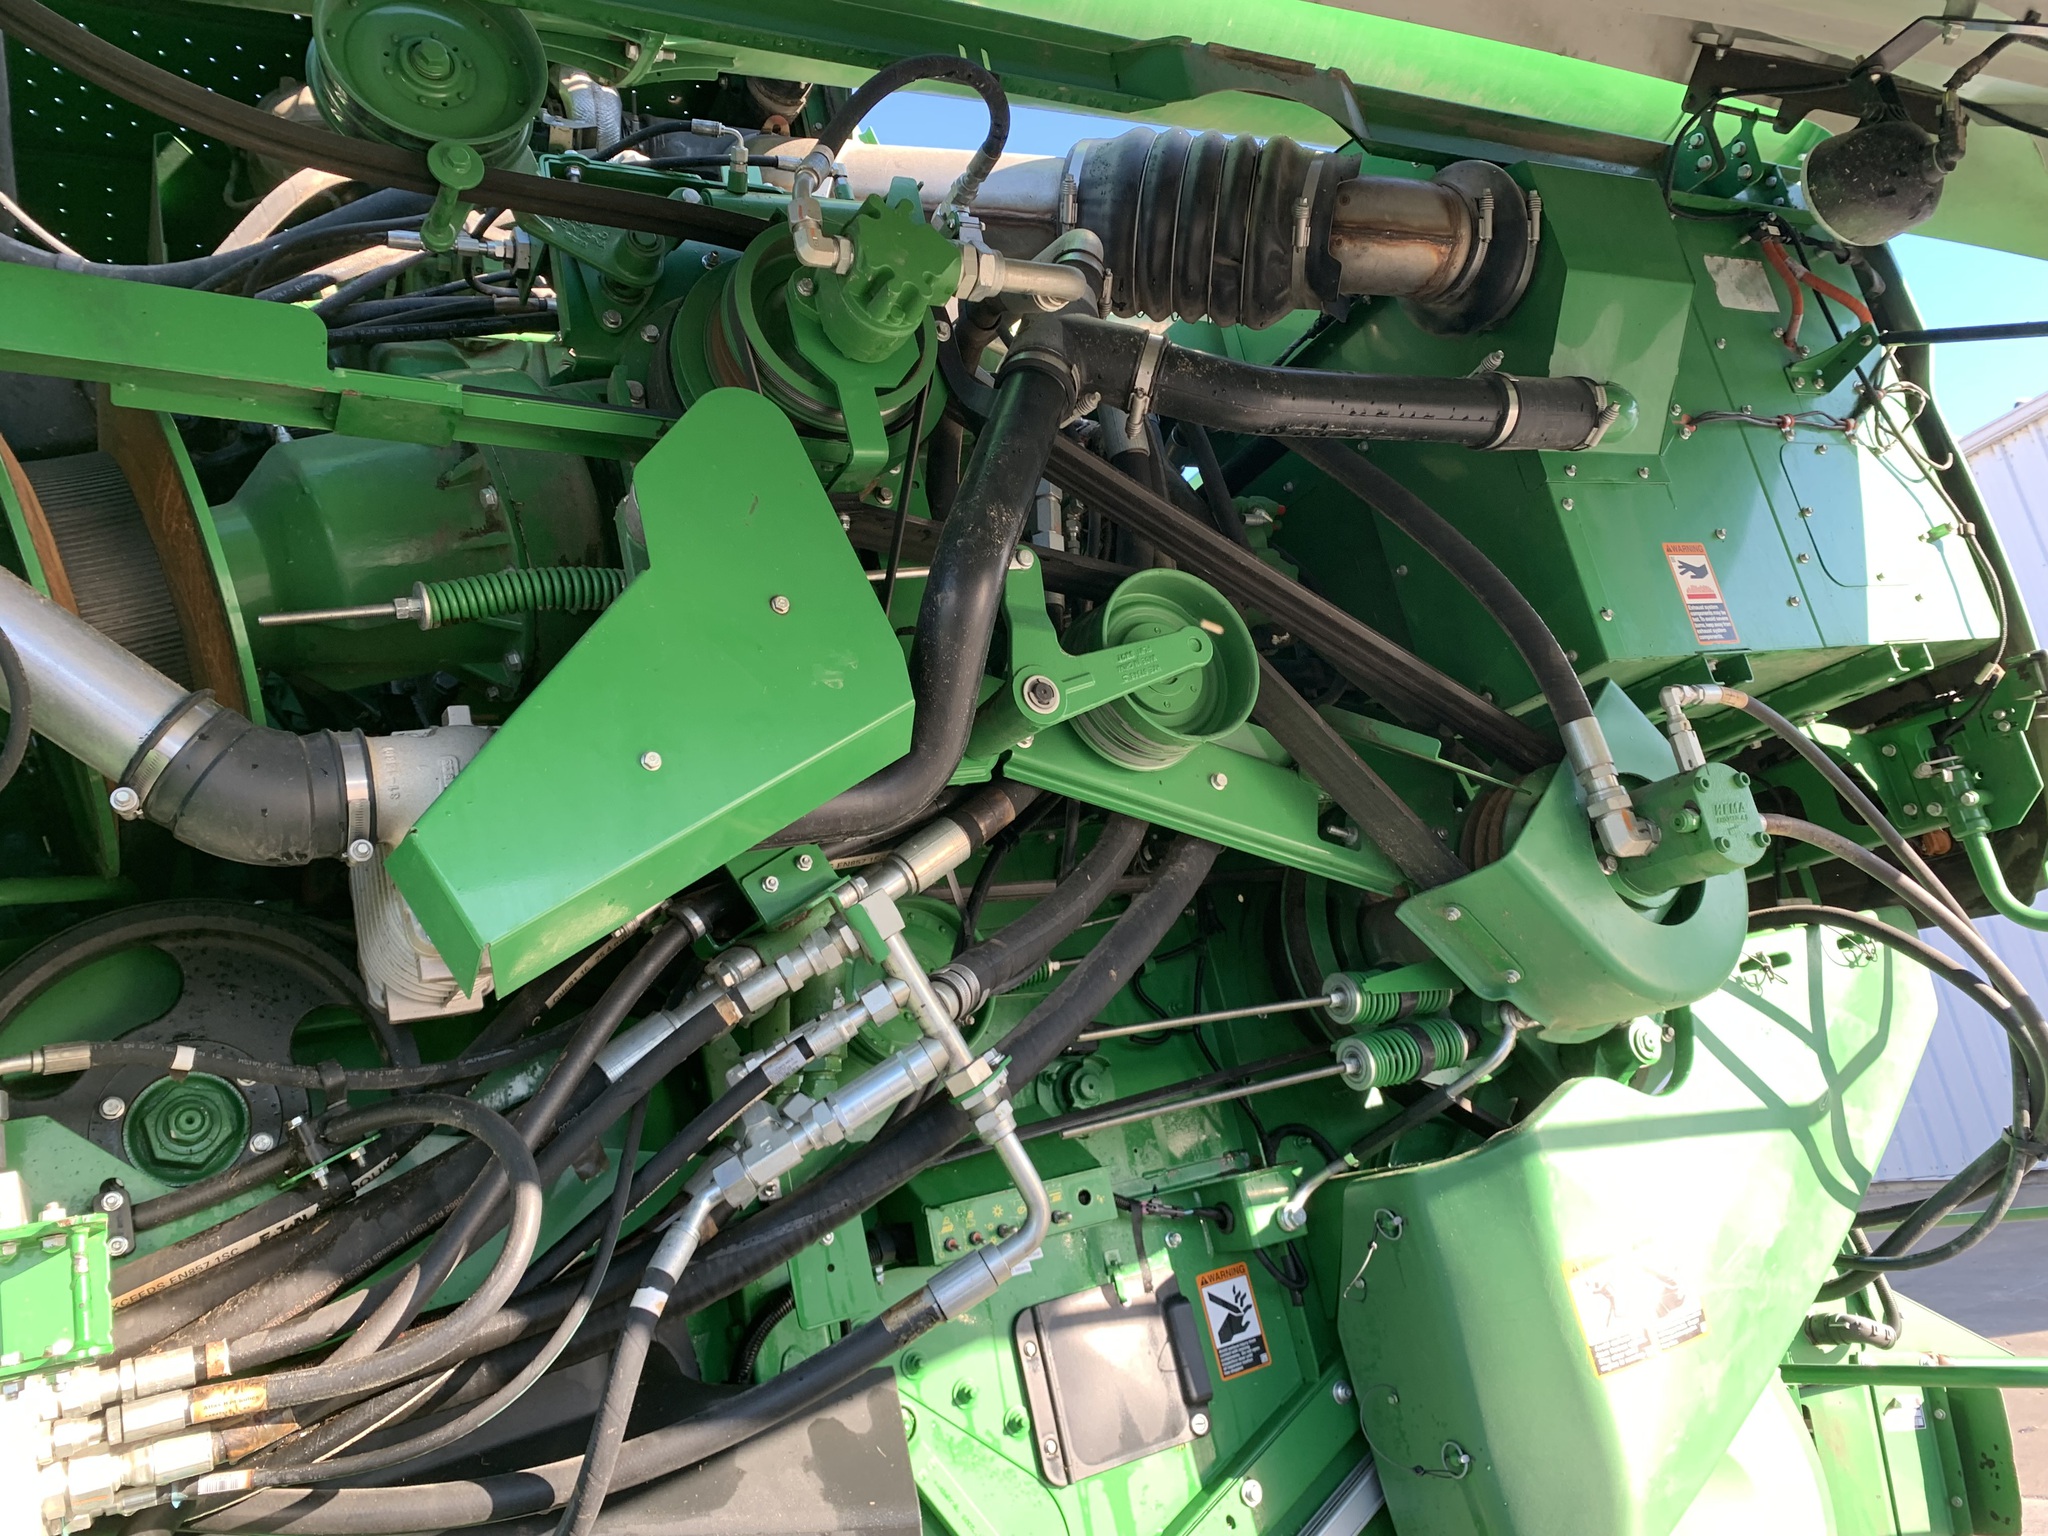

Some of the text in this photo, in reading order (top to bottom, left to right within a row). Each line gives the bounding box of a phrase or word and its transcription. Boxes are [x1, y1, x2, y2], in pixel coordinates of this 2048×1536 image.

[1672, 544, 1704, 553] WARNING
[372, 1236, 406, 1262] Exceeds
[112, 1246, 240, 1310] XCEEDS EN857 1SC
[1208, 1264, 1246, 1284] WARNING
